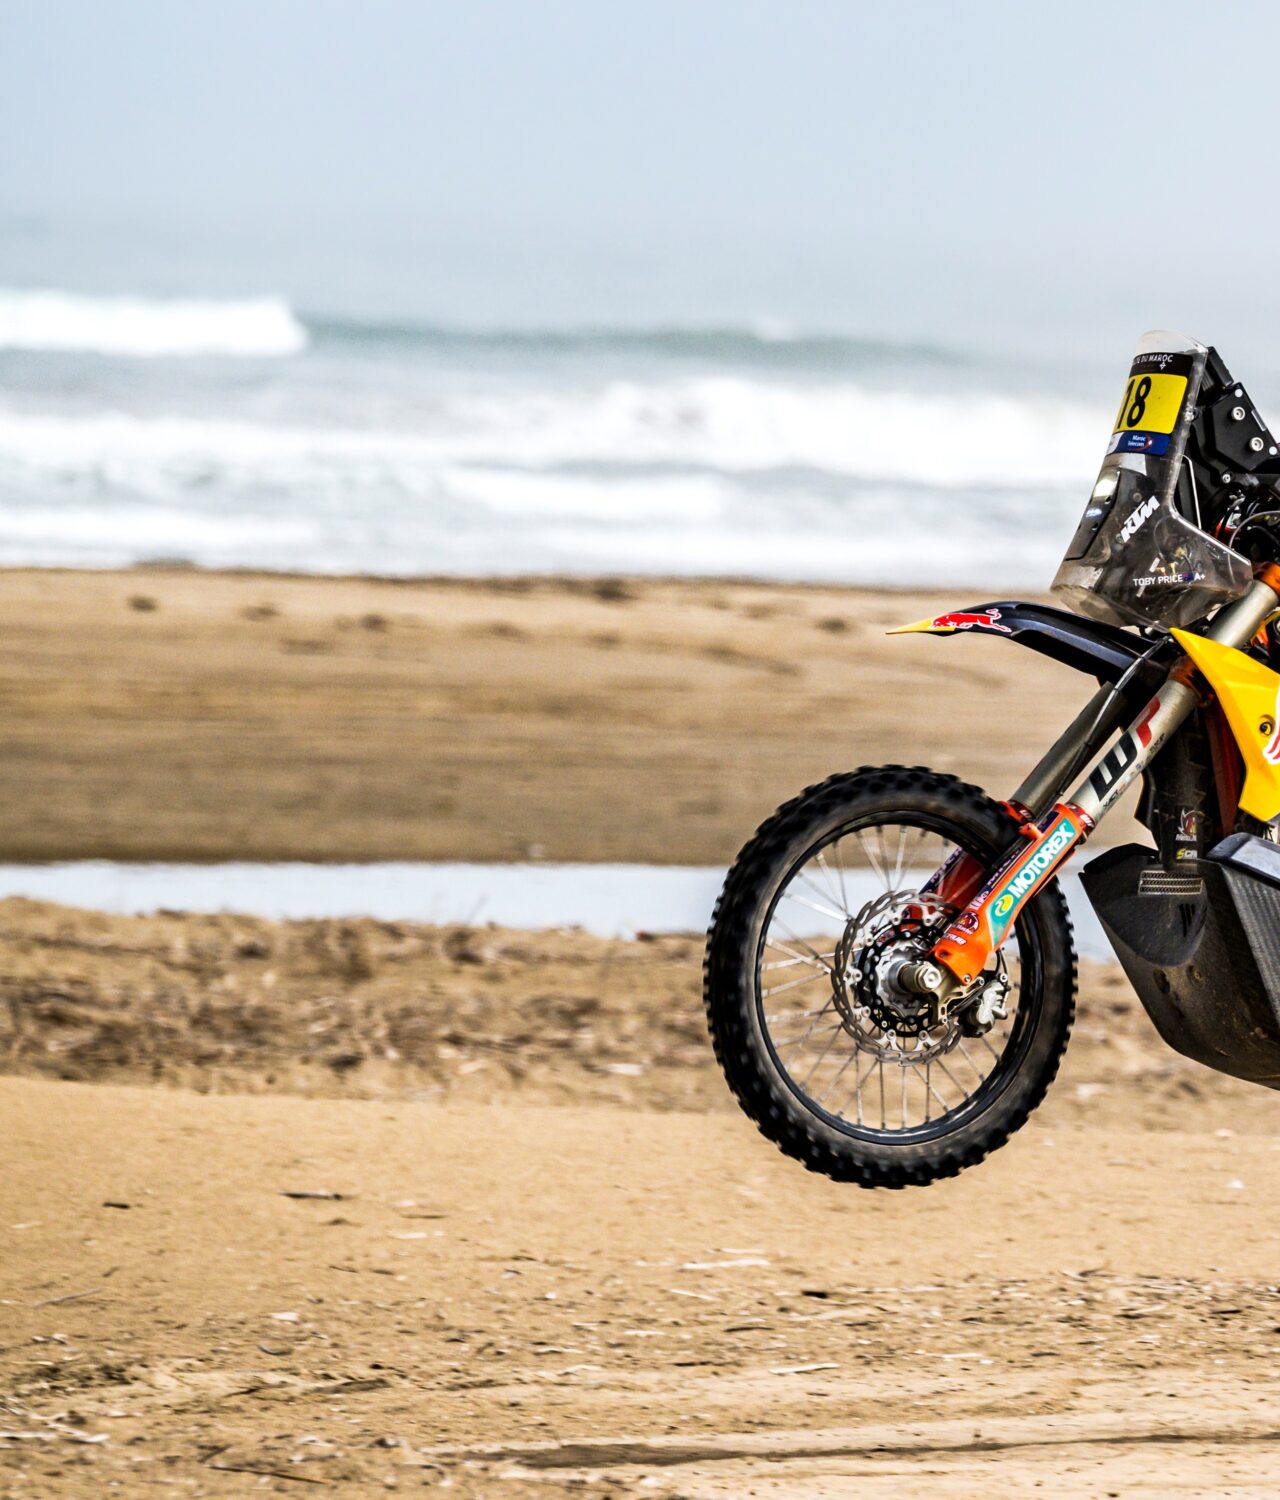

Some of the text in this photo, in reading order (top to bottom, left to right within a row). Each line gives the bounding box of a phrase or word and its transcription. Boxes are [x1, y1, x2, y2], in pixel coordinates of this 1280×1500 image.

[1148, 354, 1174, 363] MAROC
[1117, 376, 1152, 430] 18
[1120, 495, 1160, 542] KTM
[1132, 577, 1156, 587] TOBY
[1157, 573, 1183, 584] PRICE
[1008, 822, 1074, 898] MOTOREX
